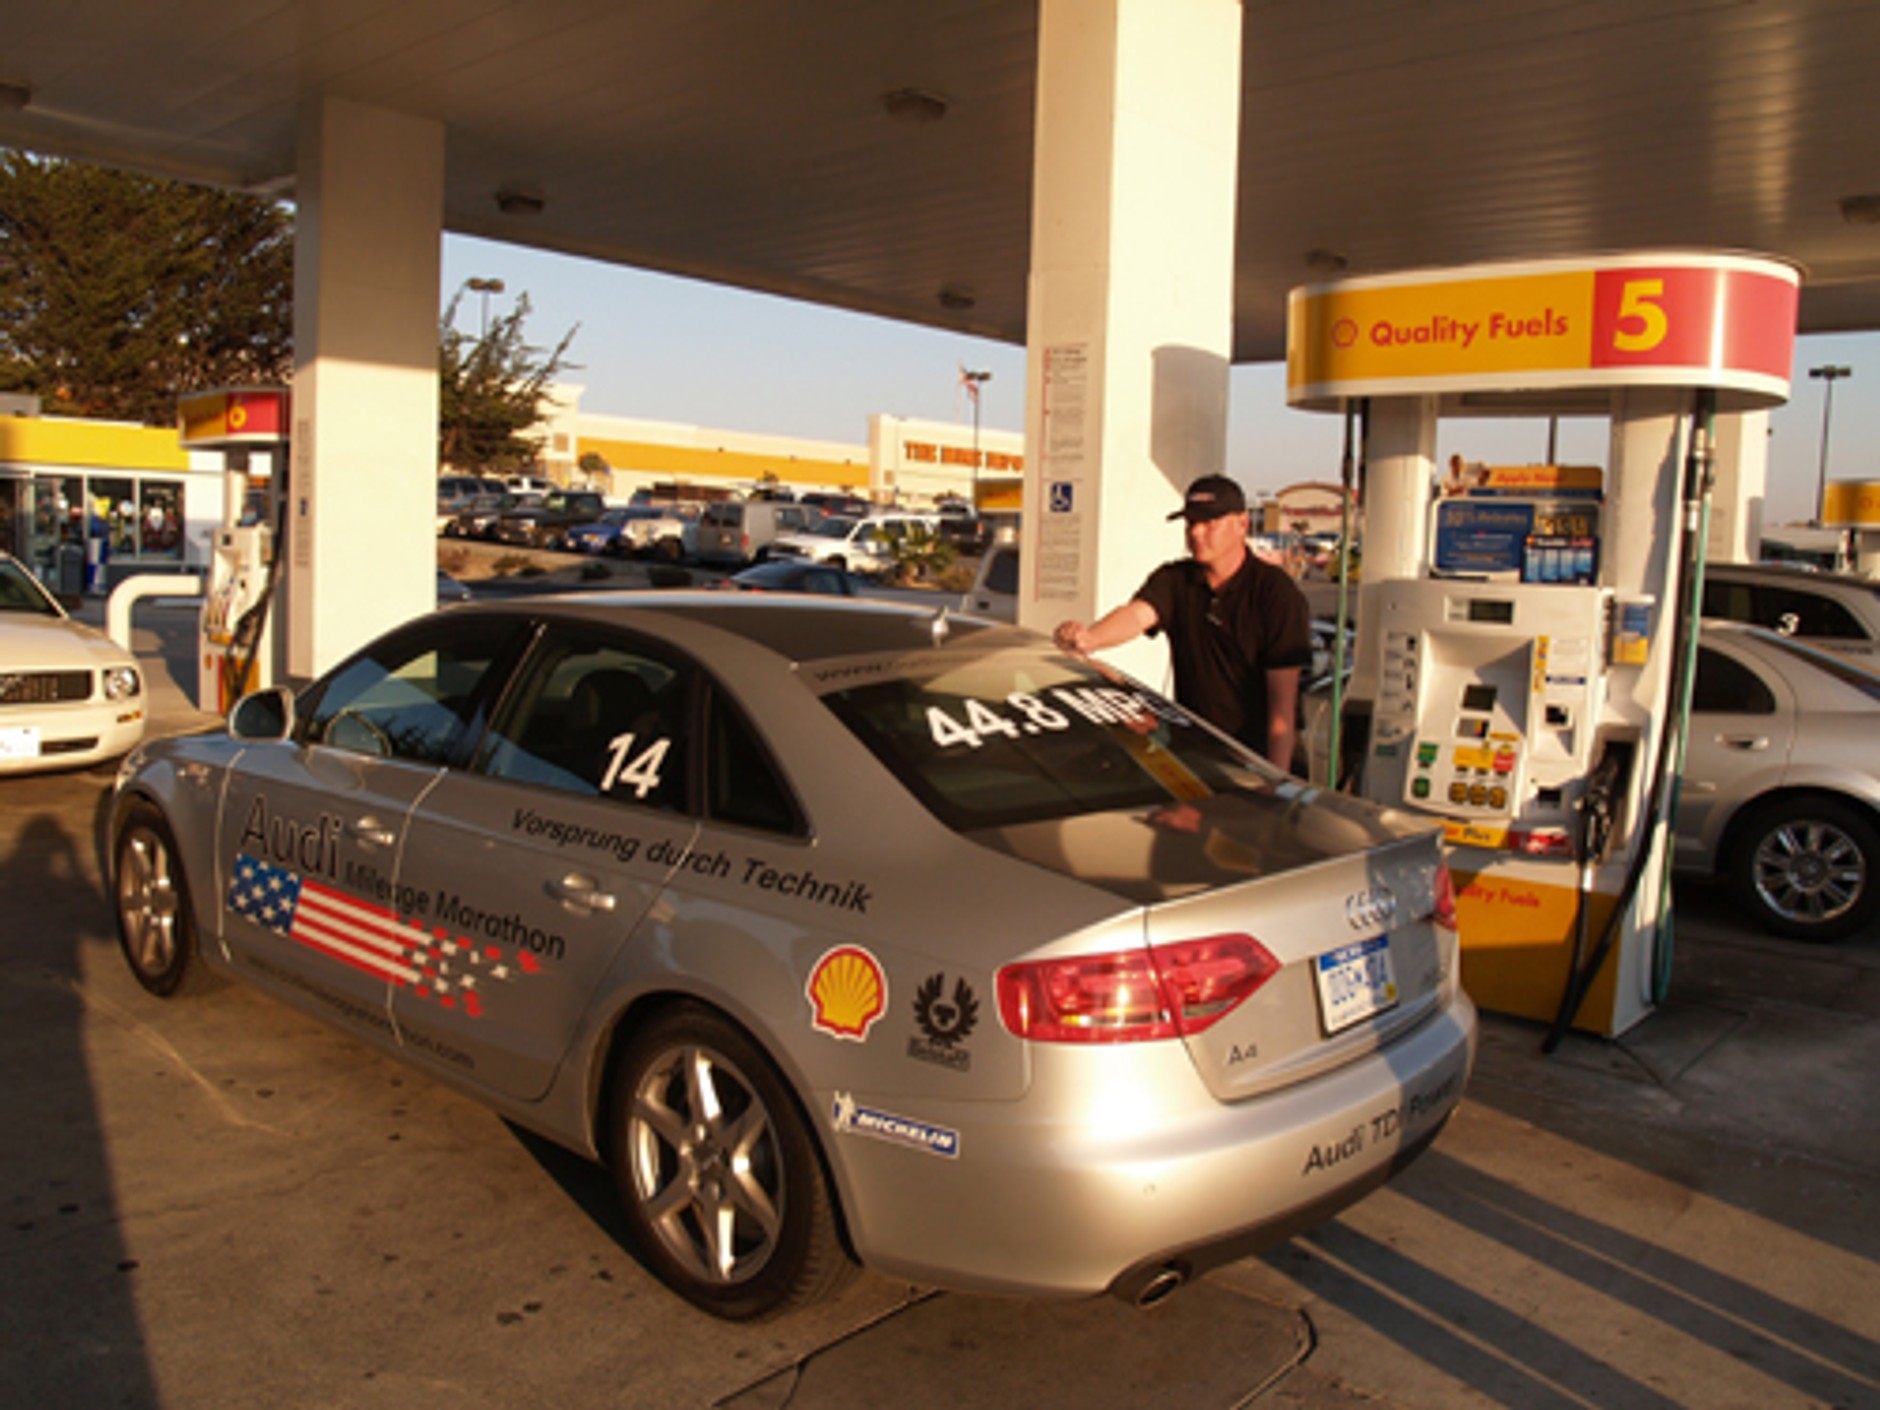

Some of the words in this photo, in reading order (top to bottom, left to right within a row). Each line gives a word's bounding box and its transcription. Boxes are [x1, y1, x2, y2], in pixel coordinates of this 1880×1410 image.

[1369, 315, 1481, 350] Quality
[1488, 308, 1569, 340] Fuels
[1613, 279, 1668, 352] 5
[1776, 612, 1800, 638] 3
[926, 691, 1069, 750] 44.8
[600, 732, 672, 800] 14
[240, 793, 344, 881] Audi
[511, 807, 642, 864] Vorsprung
[646, 840, 732, 882] durch
[740, 857, 875, 915] Technik
[343, 858, 431, 918] Mileage
[435, 890, 567, 961] Marathon
[1227, 1042, 1258, 1067] A4
[1302, 1124, 1366, 1177] Audi
